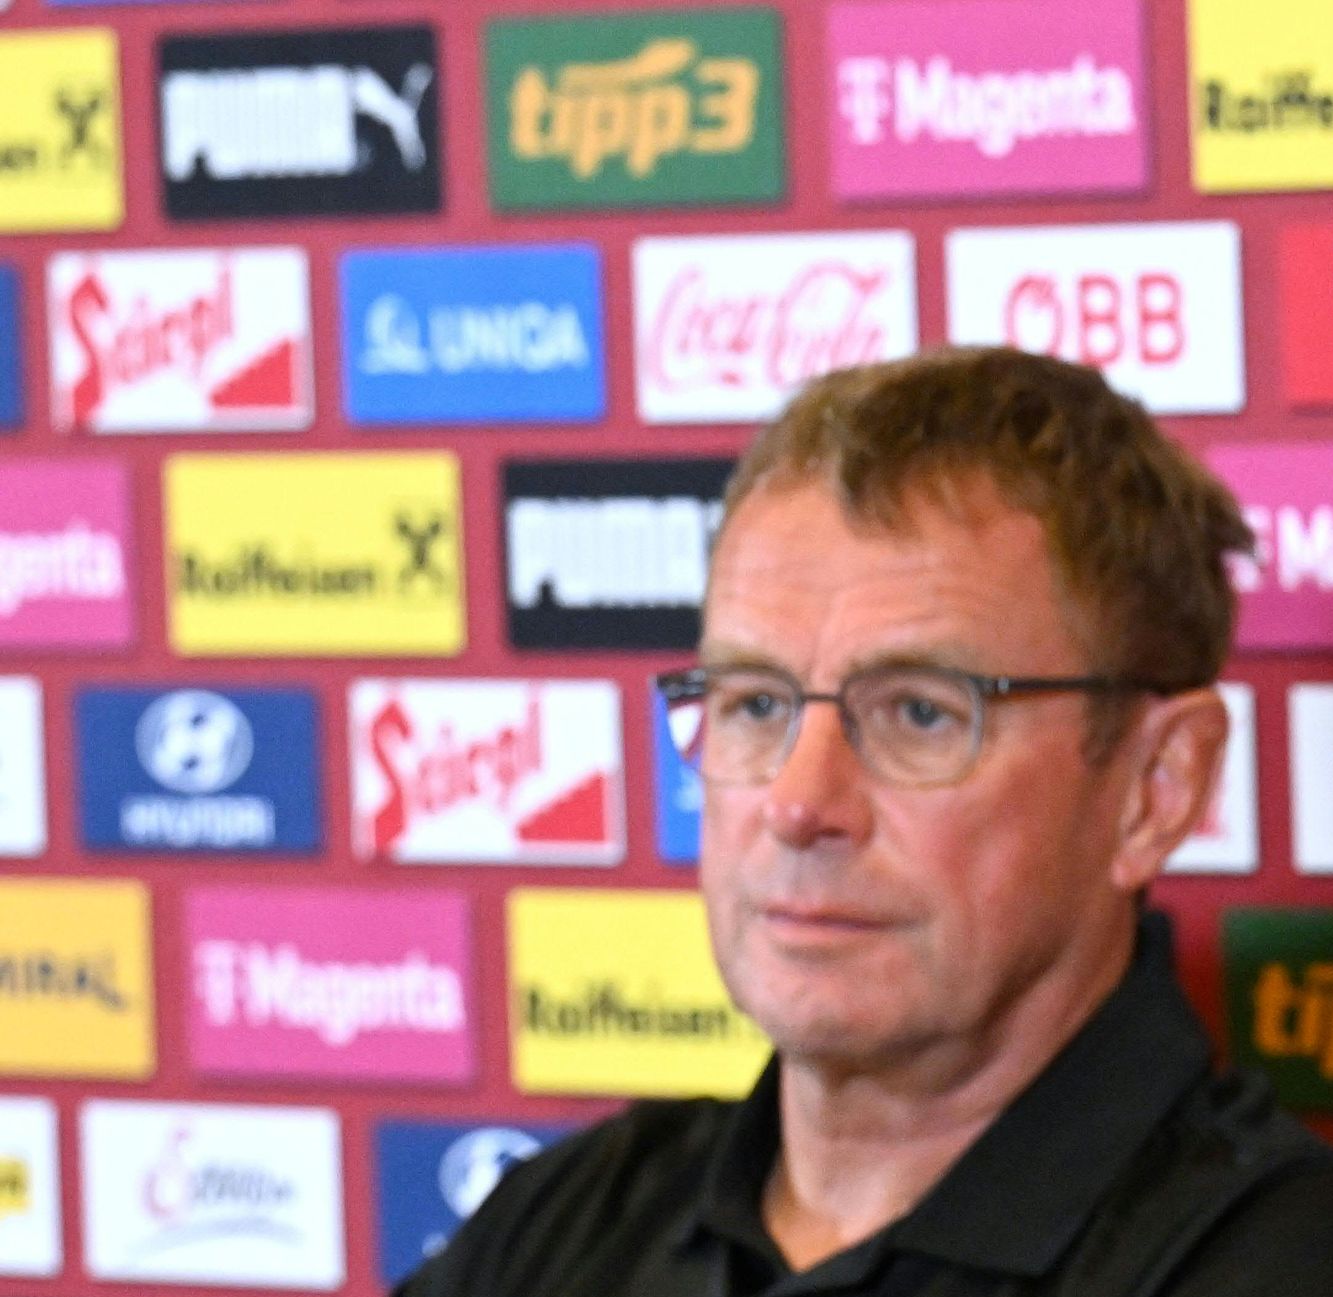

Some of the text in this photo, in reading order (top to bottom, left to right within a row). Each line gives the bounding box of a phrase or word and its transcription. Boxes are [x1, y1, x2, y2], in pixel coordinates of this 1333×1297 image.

[509, 40, 760, 179] tipp3
[895, 53, 1134, 156] Magenta
[245, 934, 467, 1045] Magenta
